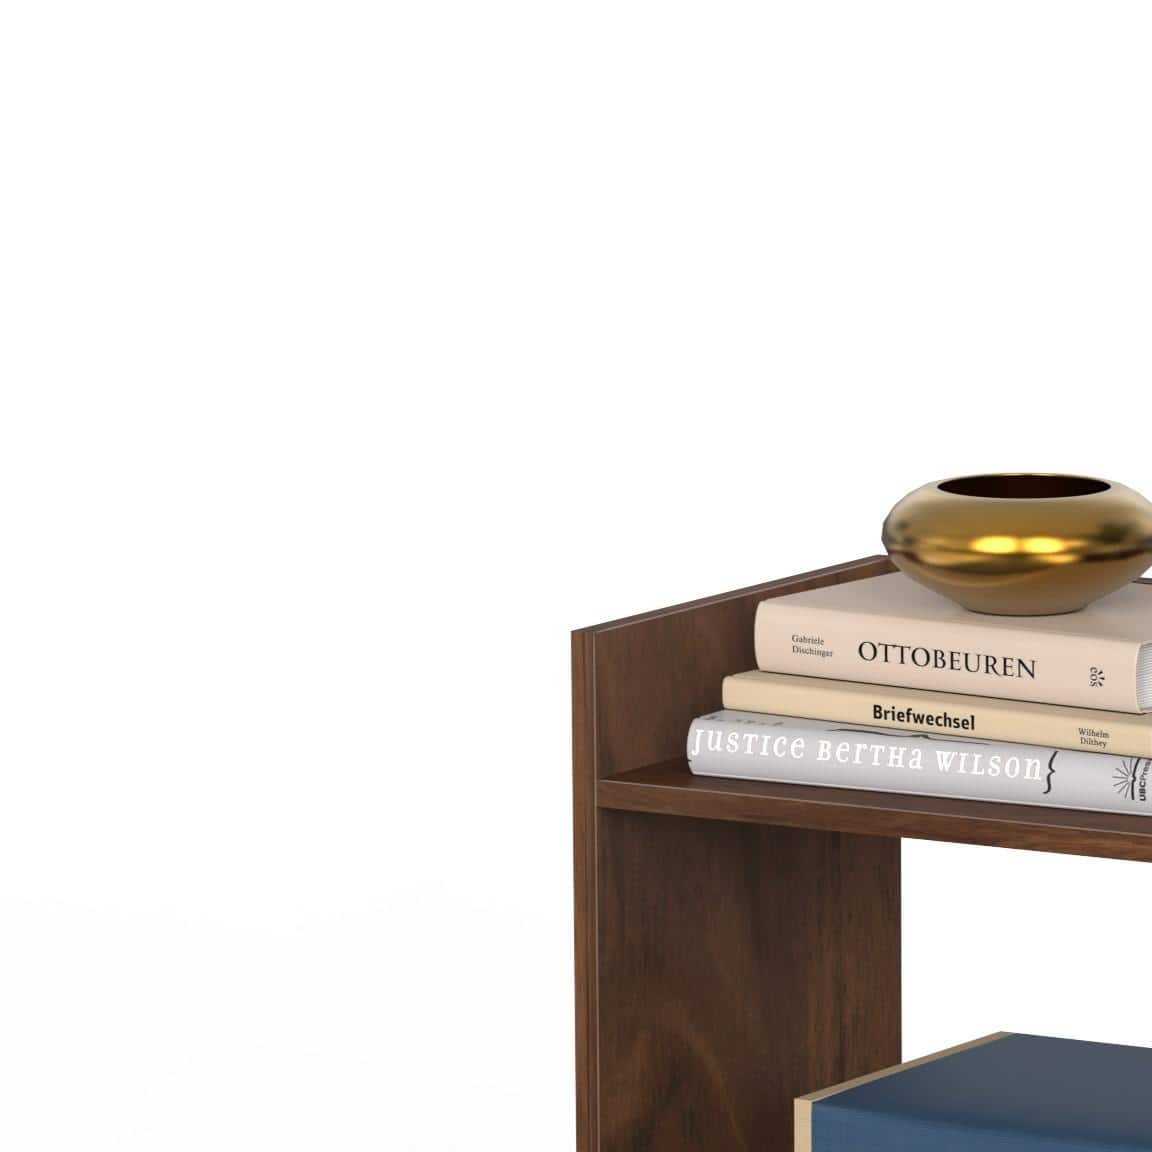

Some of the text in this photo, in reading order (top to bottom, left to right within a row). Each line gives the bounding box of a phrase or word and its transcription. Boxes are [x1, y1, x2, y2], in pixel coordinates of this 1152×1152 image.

[791, 634, 825, 646] Gabriele
[792, 645, 833, 658] Dischinger
[857, 640, 1038, 680] OTTOBEUREN
[872, 704, 976, 731] Briefwechsel
[1078, 727, 1110, 738] Wilhelm
